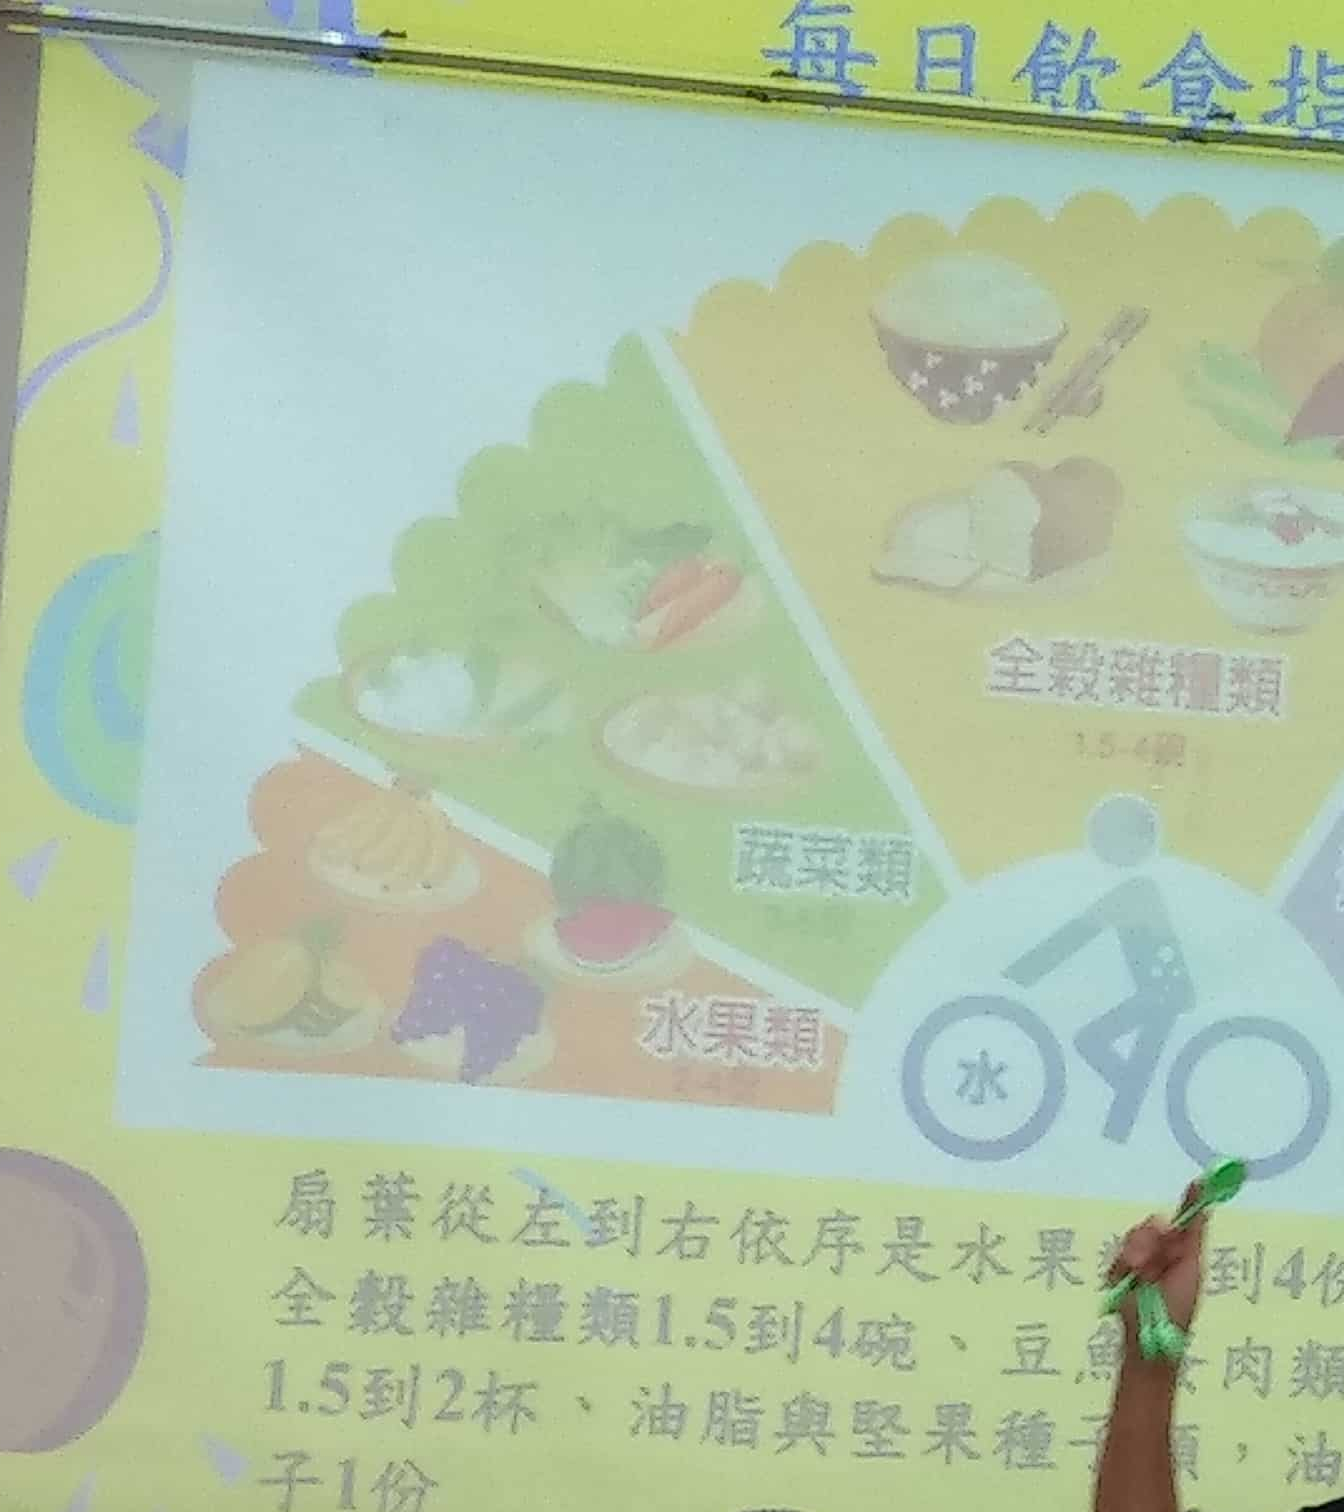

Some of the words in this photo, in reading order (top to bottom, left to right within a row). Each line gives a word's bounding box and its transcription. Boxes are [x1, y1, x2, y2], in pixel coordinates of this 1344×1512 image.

[734, 824, 914, 899] 蔬菜類
[642, 997, 822, 1065] 水果類
[955, 1048, 1009, 1105] 水
